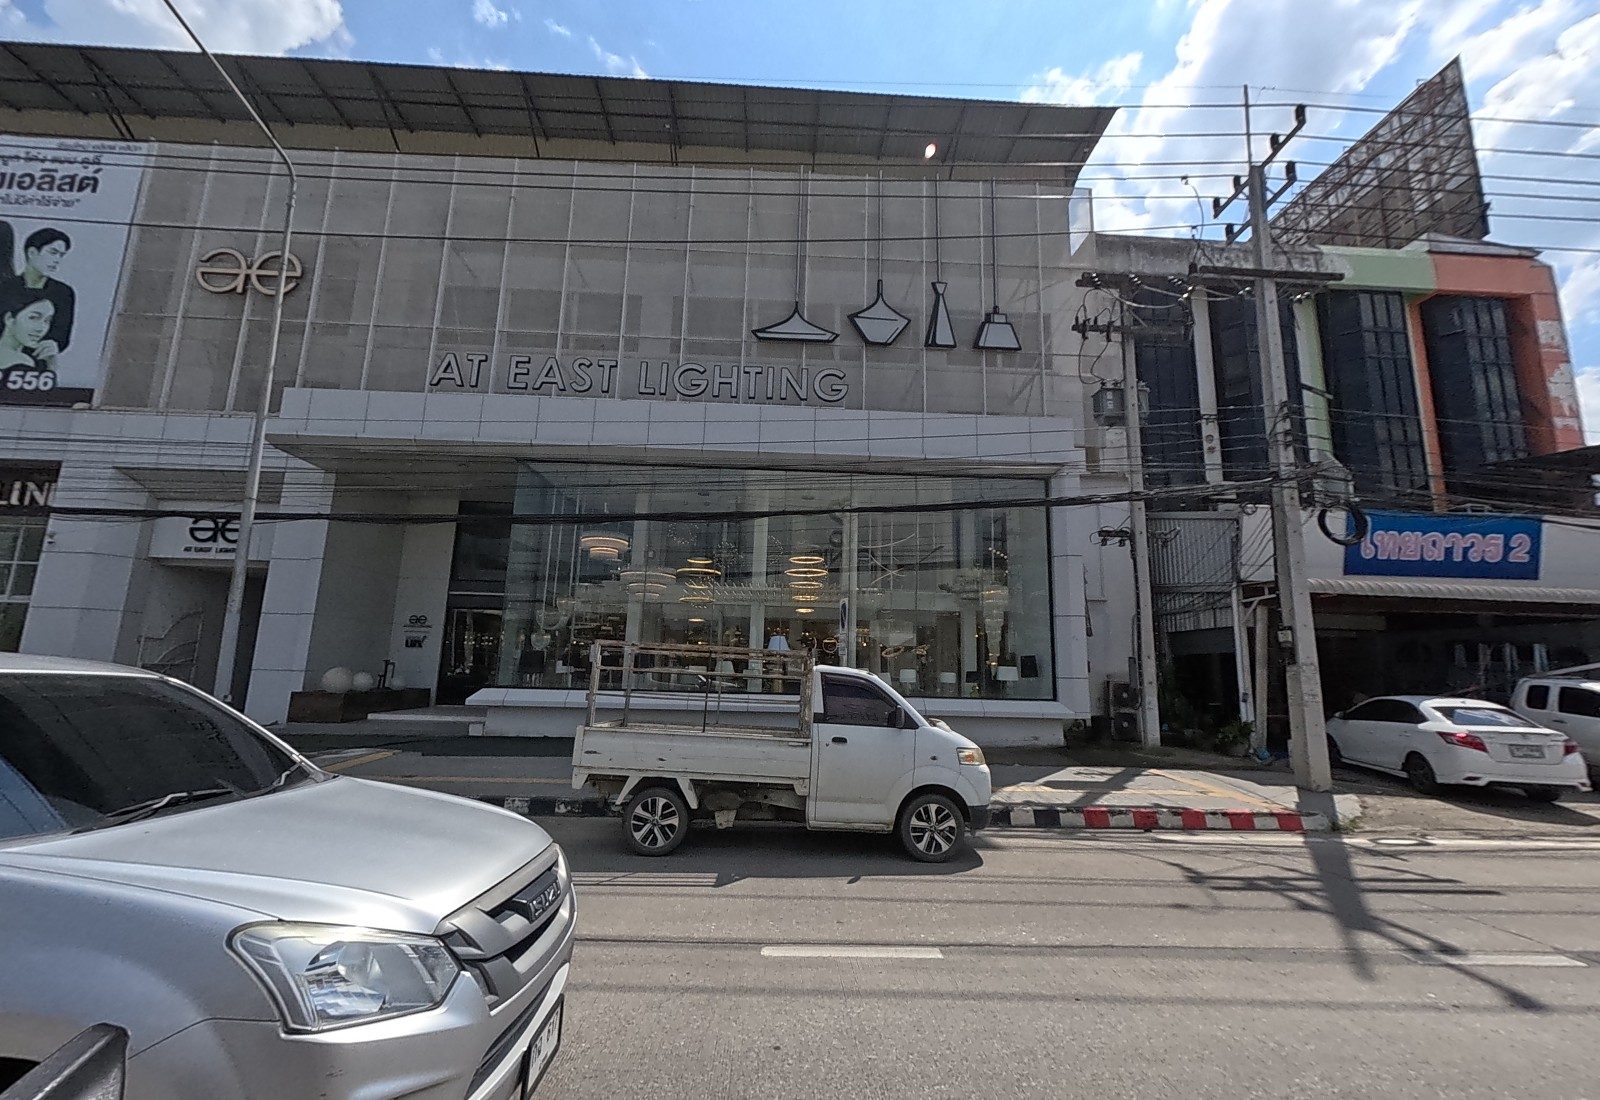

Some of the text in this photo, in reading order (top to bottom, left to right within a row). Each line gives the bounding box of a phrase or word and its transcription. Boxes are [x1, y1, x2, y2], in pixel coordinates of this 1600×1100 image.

[6, 370, 54, 391] 556
[430, 352, 850, 402] AT EAST LIGHTING
[1508, 533, 1532, 563] 2
[529, 880, 561, 920] ISUZU
